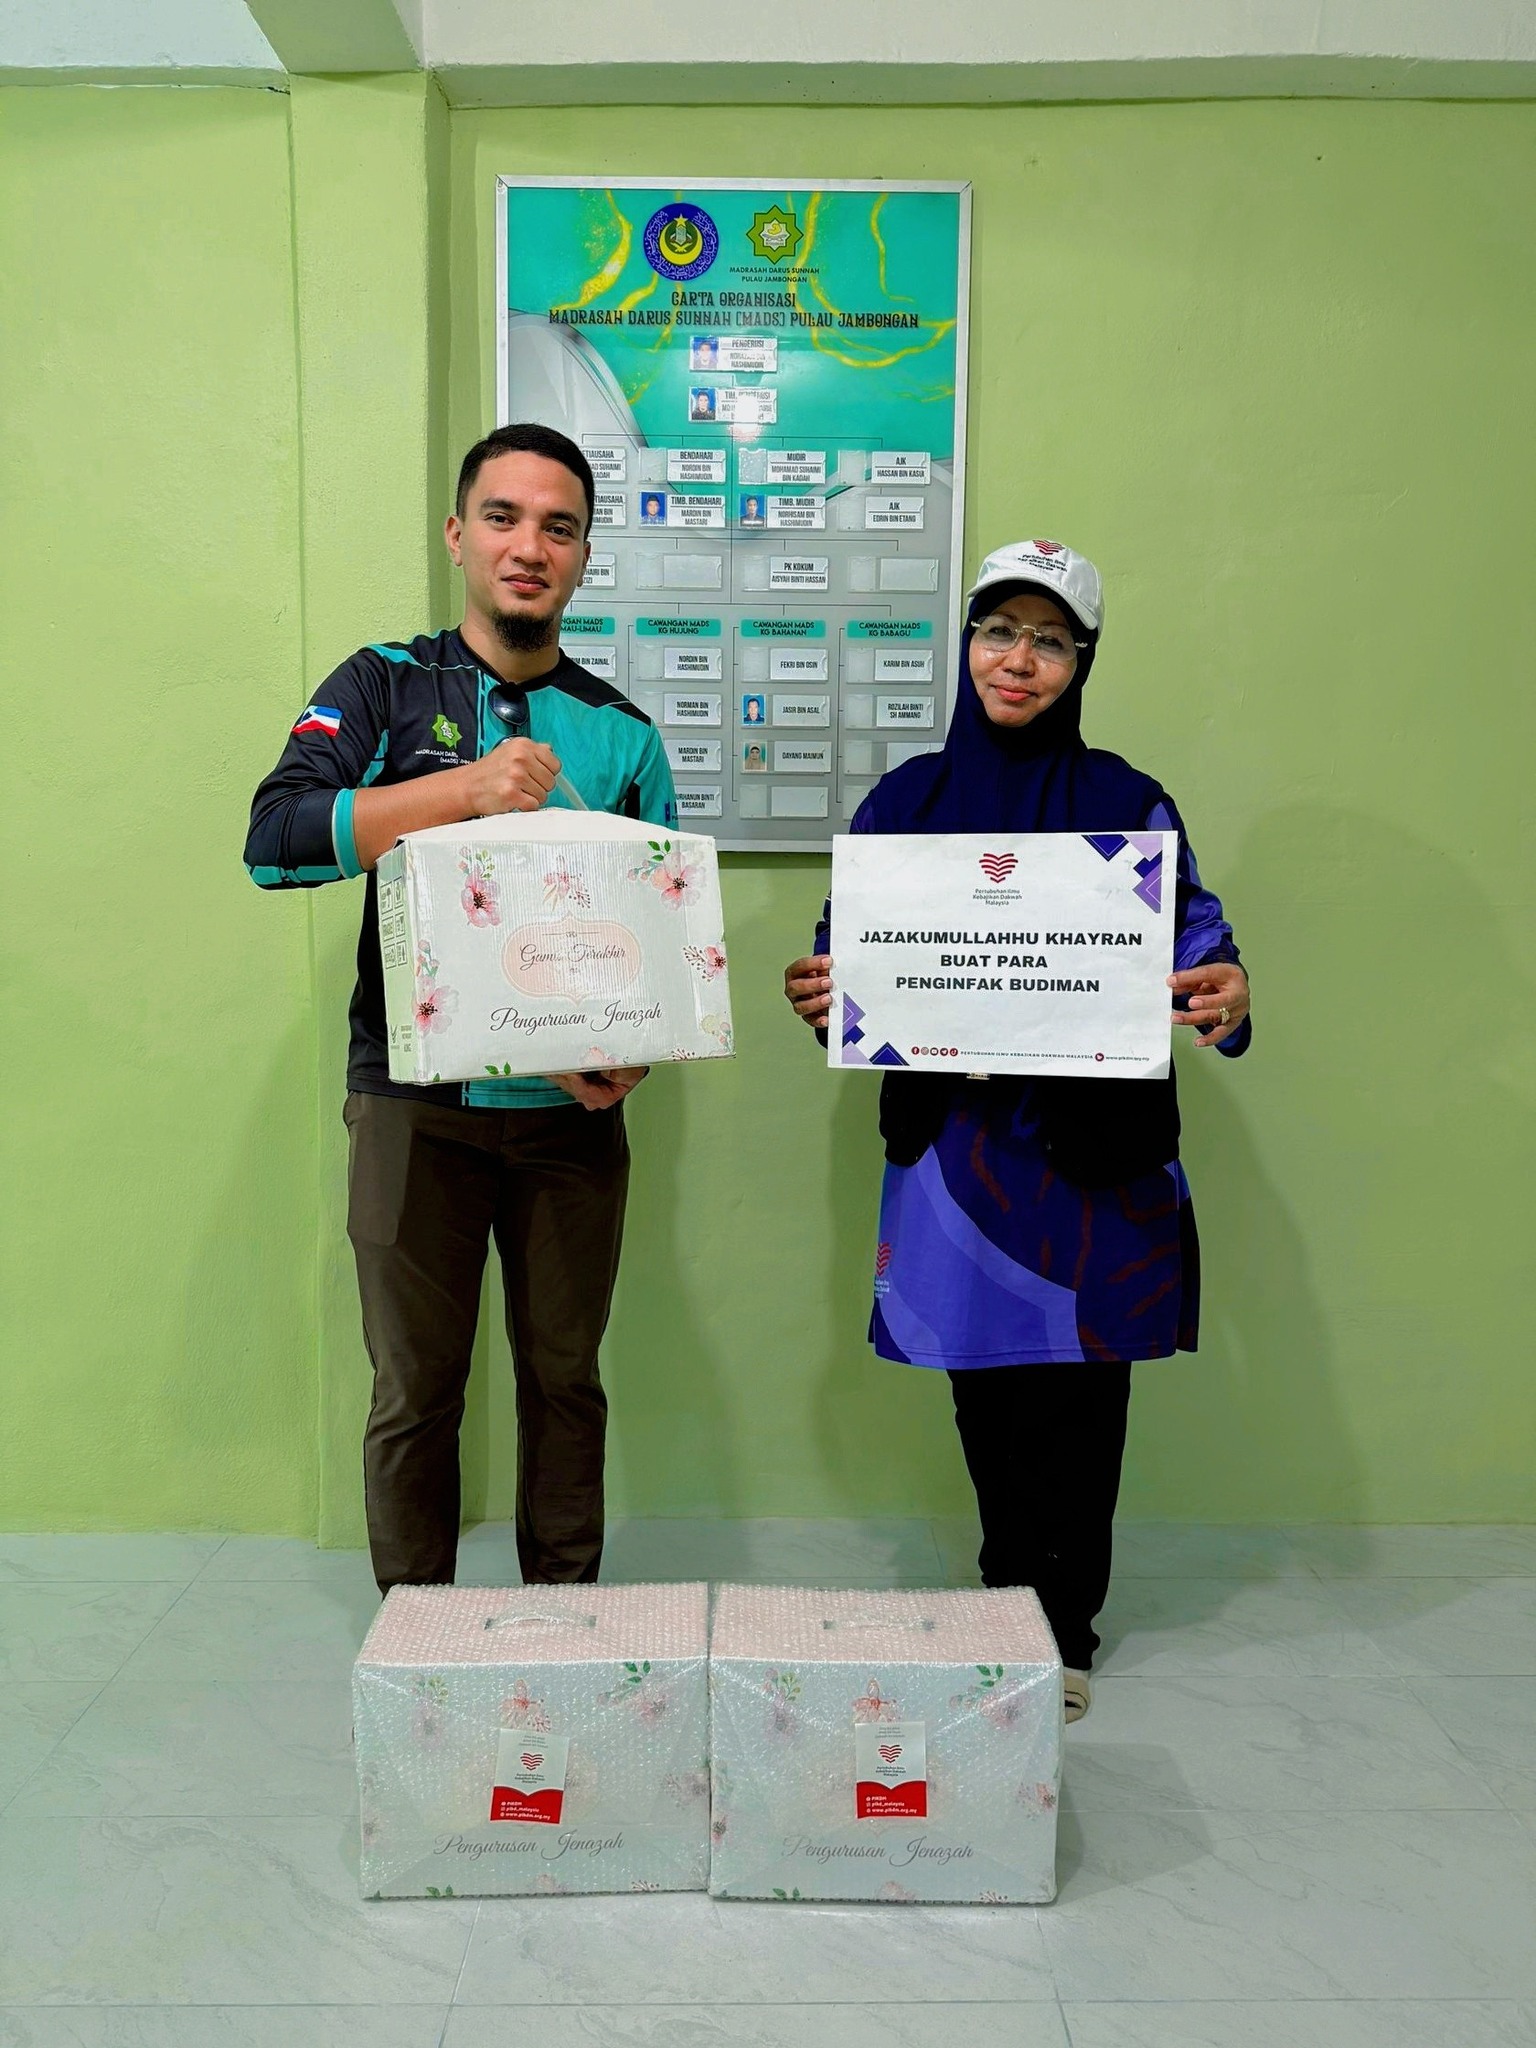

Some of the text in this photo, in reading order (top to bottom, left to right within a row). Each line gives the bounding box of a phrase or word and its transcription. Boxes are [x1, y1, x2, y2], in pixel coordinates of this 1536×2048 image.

[671, 292, 796, 307] CARTA ORGANISASI
[549, 310, 623, 325] MADRASAH
[628, 310, 671, 325] DARUS
[676, 311, 731, 325] SUNNAH
[790, 312, 833, 327] PULAU
[838, 313, 919, 328] JAMBONGAN
[680, 451, 713, 460] BENDAHARI
[787, 453, 806, 461] MUDIR
[896, 457, 906, 465] AJK
[702, 464, 711, 472] BIN
[877, 470, 898, 478] HASSAN
[899, 470, 908, 478] BIN
[671, 497, 722, 506] TIMB. BENDAHARI
[779, 498, 815, 507] TIMB. MUDIR
[889, 503, 900, 511] AJK
[784, 563, 814, 571] PK KOKUM
[600, 568, 610, 576] BIN
[805, 576, 826, 584] HASSAN
[647, 619, 710, 628] CAWANGAN MADS
[591, 658, 610, 666] ZAINAL
[678, 656, 708, 664] NORDIN BIN
[883, 660, 900, 668] KARIM
[677, 664, 710, 672] HASHIMUDIN
[780, 661, 796, 669] FEKRI
[677, 710, 709, 718] HASHIMUDIN
[678, 747, 708, 755] MARDIN BIN
[782, 752, 802, 760] DAYANG
[701, 793, 715, 801] BINTI
[682, 801, 706, 809] BASARAN
[859, 931, 1143, 946] JAZAKUMULLAHHU KHAYRAN
[940, 955, 1048, 969] BUAT PARA
[896, 977, 1100, 993] PENGINFAK BUDIMAN
[490, 1000, 663, 1036] Pengurusan Jenazah
[433, 1829, 625, 1861] Pengurusan Jenazah
[781, 1835, 974, 1867] Pengurusan Jenazah
